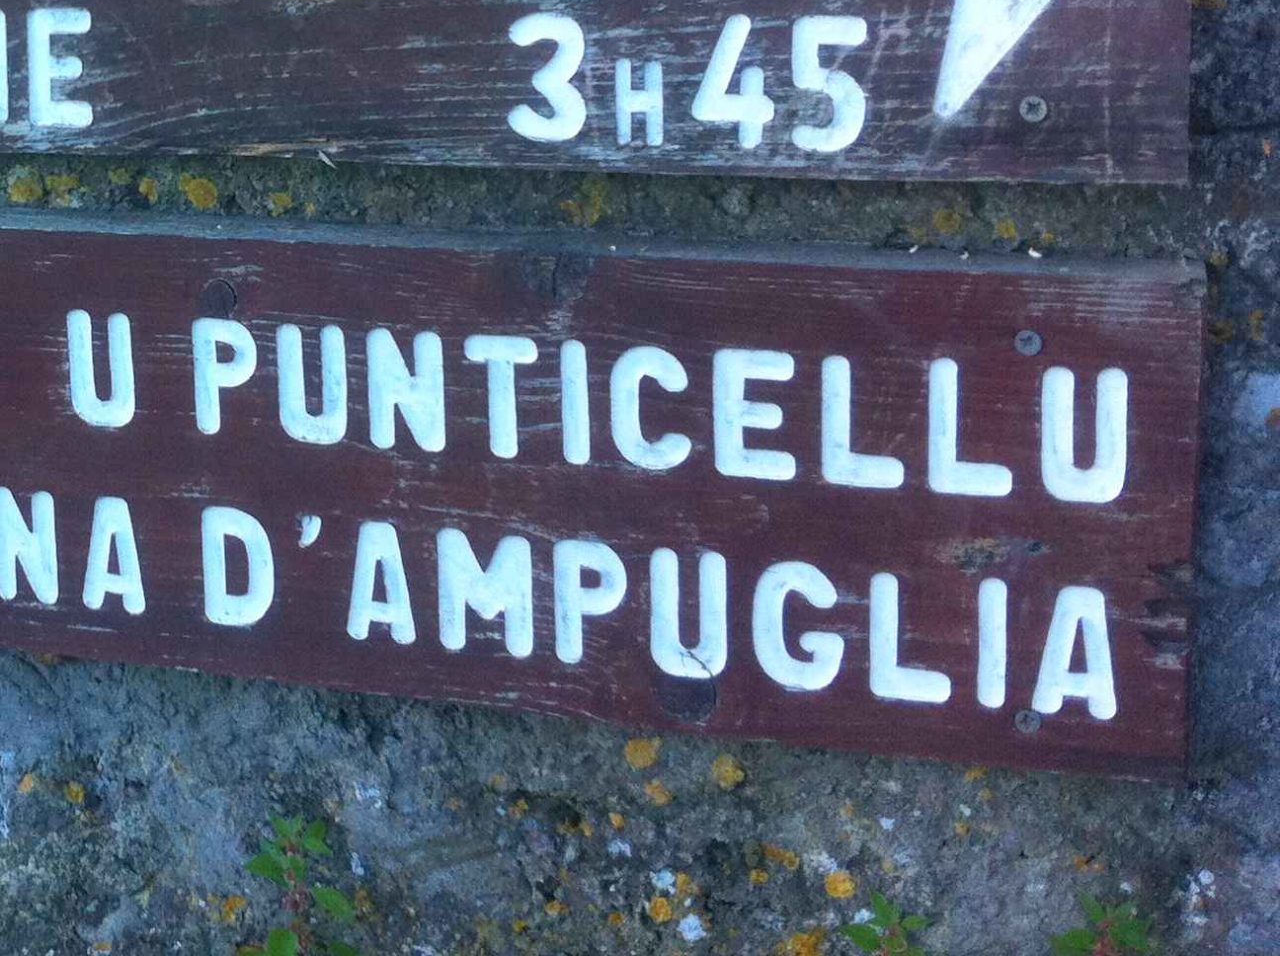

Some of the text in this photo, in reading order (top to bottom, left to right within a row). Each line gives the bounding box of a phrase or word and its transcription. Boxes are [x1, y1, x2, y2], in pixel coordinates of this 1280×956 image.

[506, 12, 867, 152] 3H45
[66, 308, 135, 428] U
[190, 317, 1129, 504] PUNTICELLU
[200, 506, 1118, 721] D'AMPUGLIA
